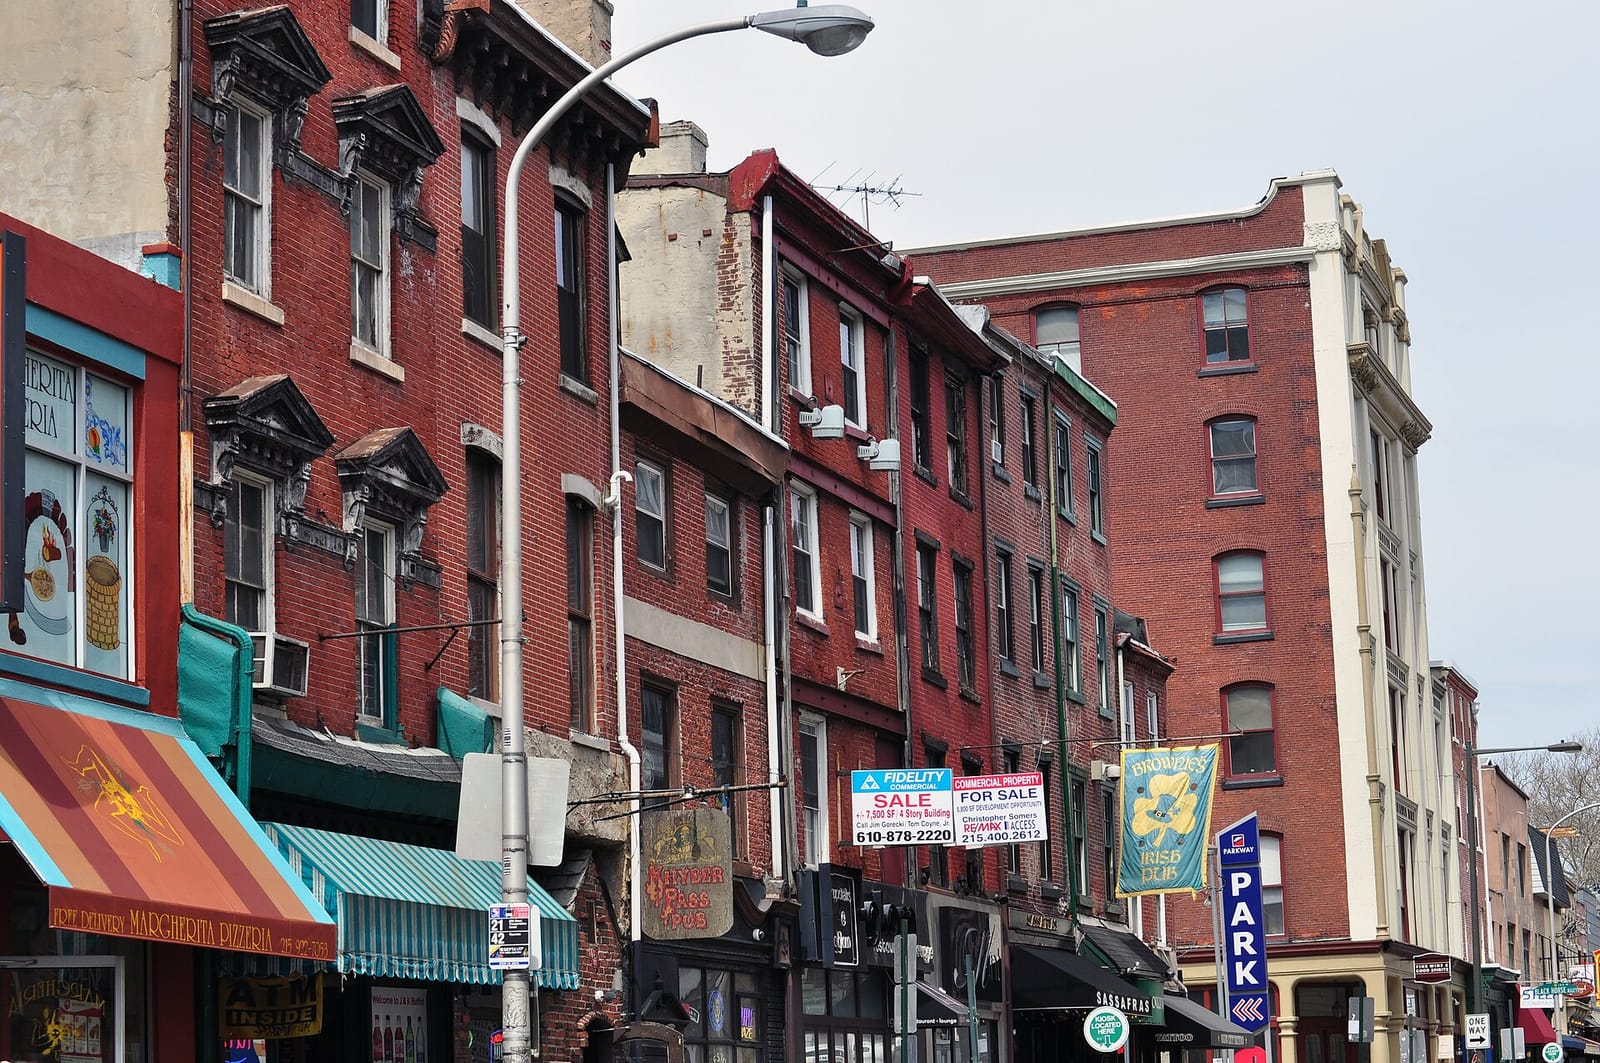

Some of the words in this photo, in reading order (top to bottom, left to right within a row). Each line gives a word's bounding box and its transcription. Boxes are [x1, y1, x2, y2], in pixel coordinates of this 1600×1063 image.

[883, 771, 945, 784] FIDELITY
[954, 779, 1002, 790] COMMERCIAL
[1003, 775, 1040, 787] PROPERTY
[889, 783, 938, 791] COMMERCIAL
[874, 793, 932, 808] SALE
[960, 791, 993, 803] FOR
[997, 788, 1038, 801] SALE
[976, 802, 1010, 812] DEVELOPMENT
[1010, 800, 1042, 809] OPPORTUNITY
[866, 809, 885, 821] 7,500
[886, 809, 895, 819] SF
[899, 808, 904, 818] 4
[905, 808, 922, 820] Story
[924, 807, 951, 819] Building
[962, 814, 1007, 824] Christopher
[1008, 812, 1038, 821] Somers
[856, 821, 869, 829] Call
[881, 820, 905, 828] Gorecki
[907, 820, 920, 828] Tom
[963, 821, 1002, 833] RE/MAX
[1010, 819, 1036, 830] ACCESS
[856, 829, 951, 843] 610-878-2220
[962, 829, 1041, 843] 215.400.2612
[1141, 850, 1182, 865] IRISH
[1223, 846, 1255, 855] PARKWAY
[1141, 866, 1178, 885] PUB
[663, 886, 711, 910] PASS
[491, 919, 504, 931] 21
[670, 911, 708, 930] PUB
[53, 907, 78, 928] FREE
[81, 910, 126, 934] DELIVERY
[129, 909, 215, 945] MARGHERITA
[219, 922, 273, 952] PIZZERIA
[1230, 872, 1259, 986] PARK
[491, 932, 505, 945] 42
[224, 976, 317, 1008] ATM
[1096, 990, 1150, 1013] SASSAFRAS
[229, 1007, 313, 1025] INSIDE
[1095, 1015, 1116, 1023] KIOSK
[1468, 1017, 1486, 1026] ONE
[1091, 1021, 1121, 1030] LOCATED
[1468, 1026, 1486, 1034] WAY
[1155, 1033, 1194, 1042] TATTOO
